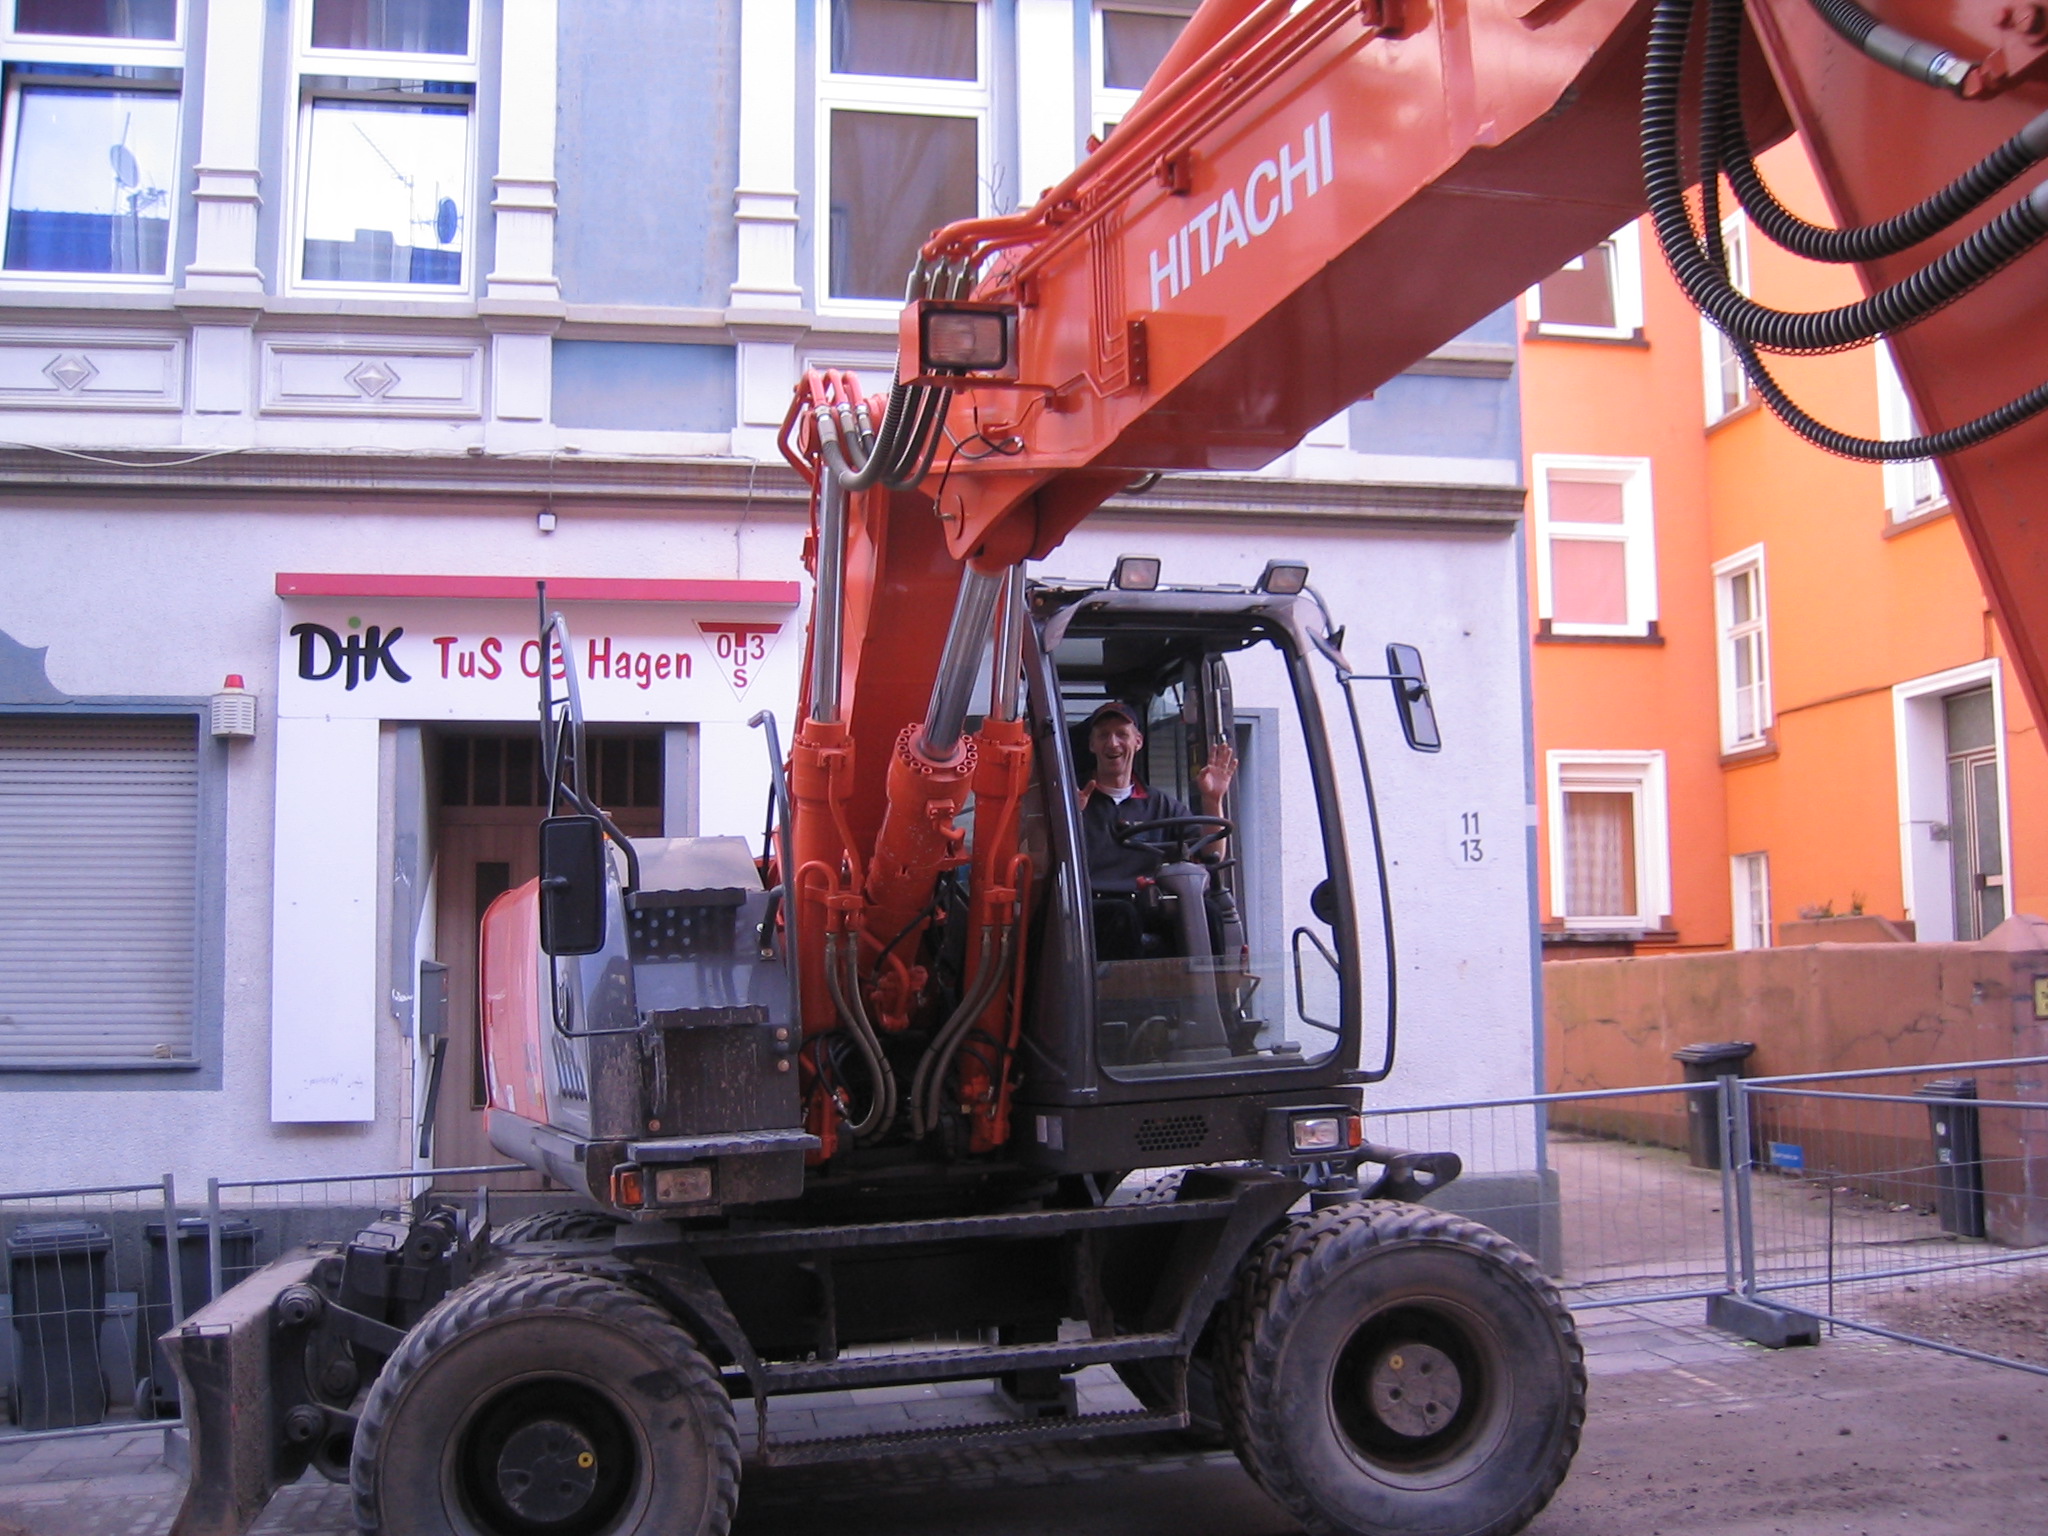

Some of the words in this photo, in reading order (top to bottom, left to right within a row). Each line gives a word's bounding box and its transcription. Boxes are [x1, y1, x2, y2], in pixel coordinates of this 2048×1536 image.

[1149, 111, 1334, 312] HITACHI
[433, 636, 503, 680] TuS
[588, 637, 693, 689] Hagen
[1461, 812, 1479, 835] 11
[1460, 839, 1484, 862] 13
